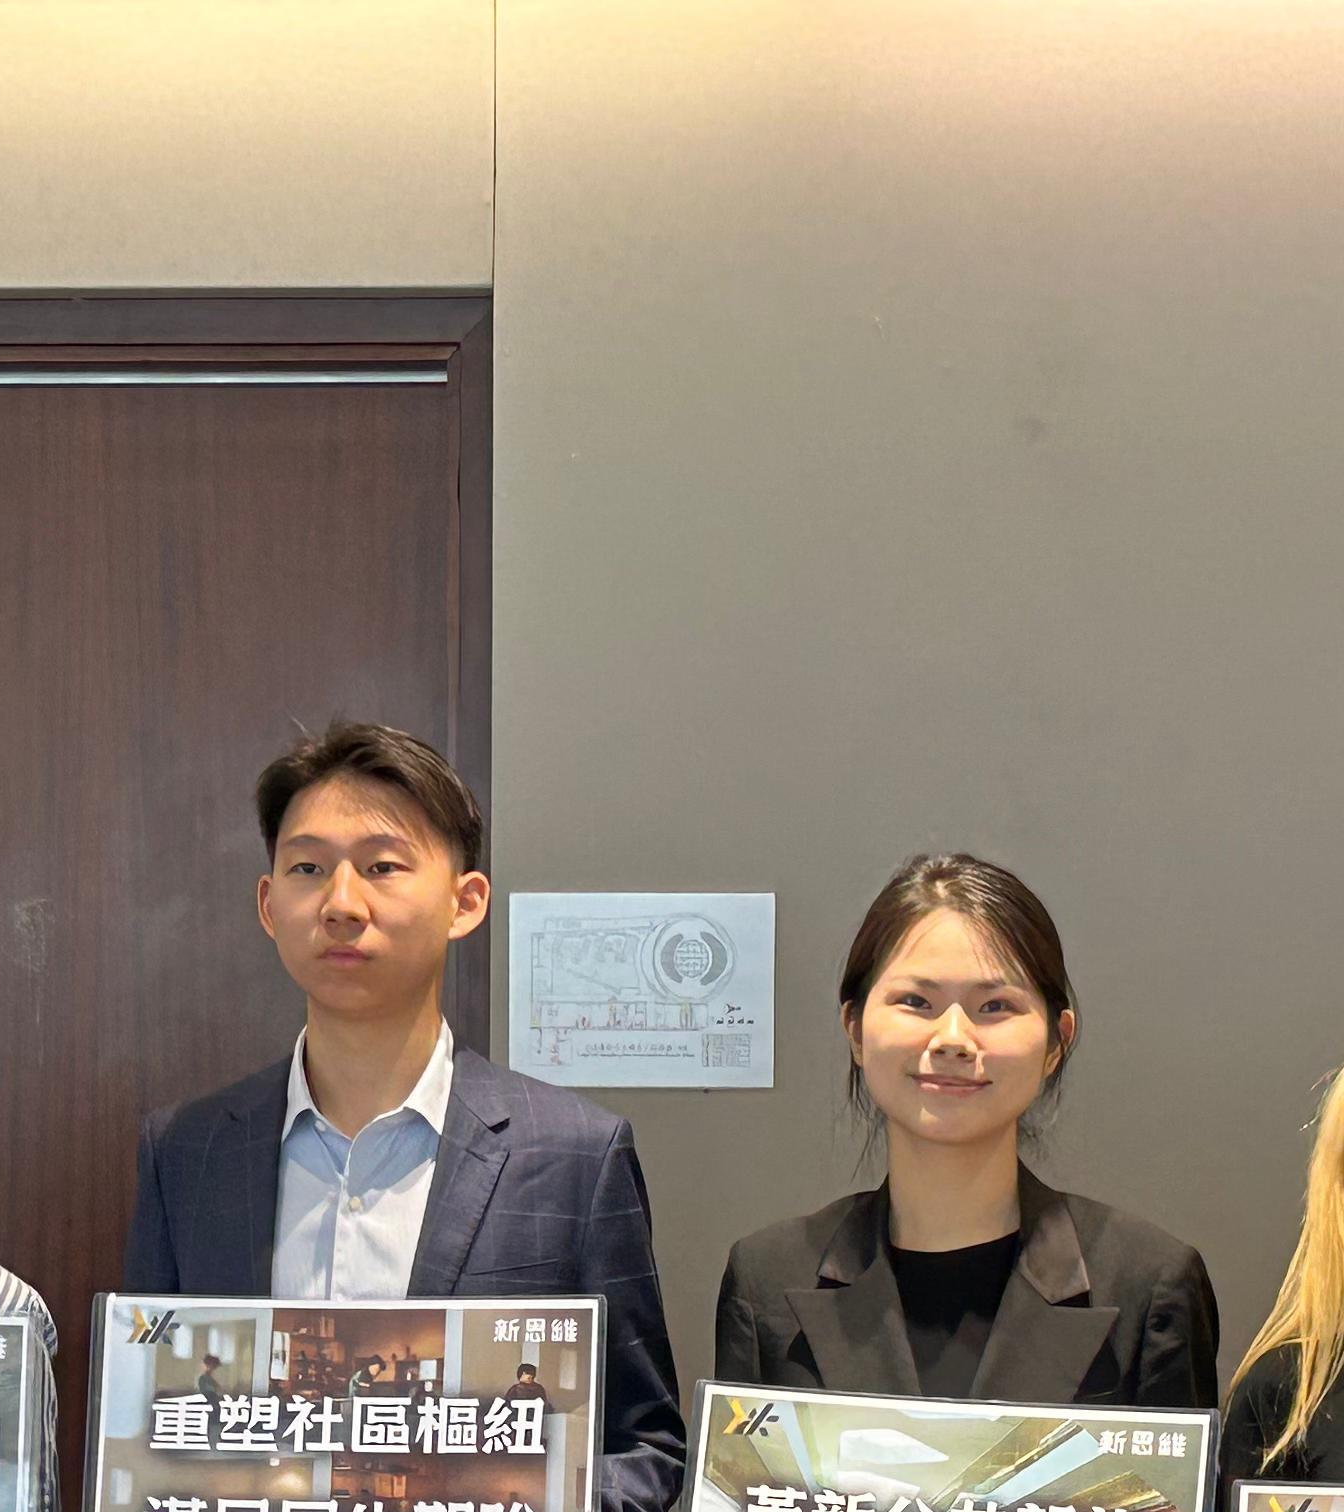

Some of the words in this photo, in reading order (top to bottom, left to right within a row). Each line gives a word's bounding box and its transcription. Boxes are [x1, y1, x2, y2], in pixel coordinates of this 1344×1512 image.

[493, 1317, 578, 1343] 新思維
[149, 1393, 546, 1454] 重塑社區樞紐
